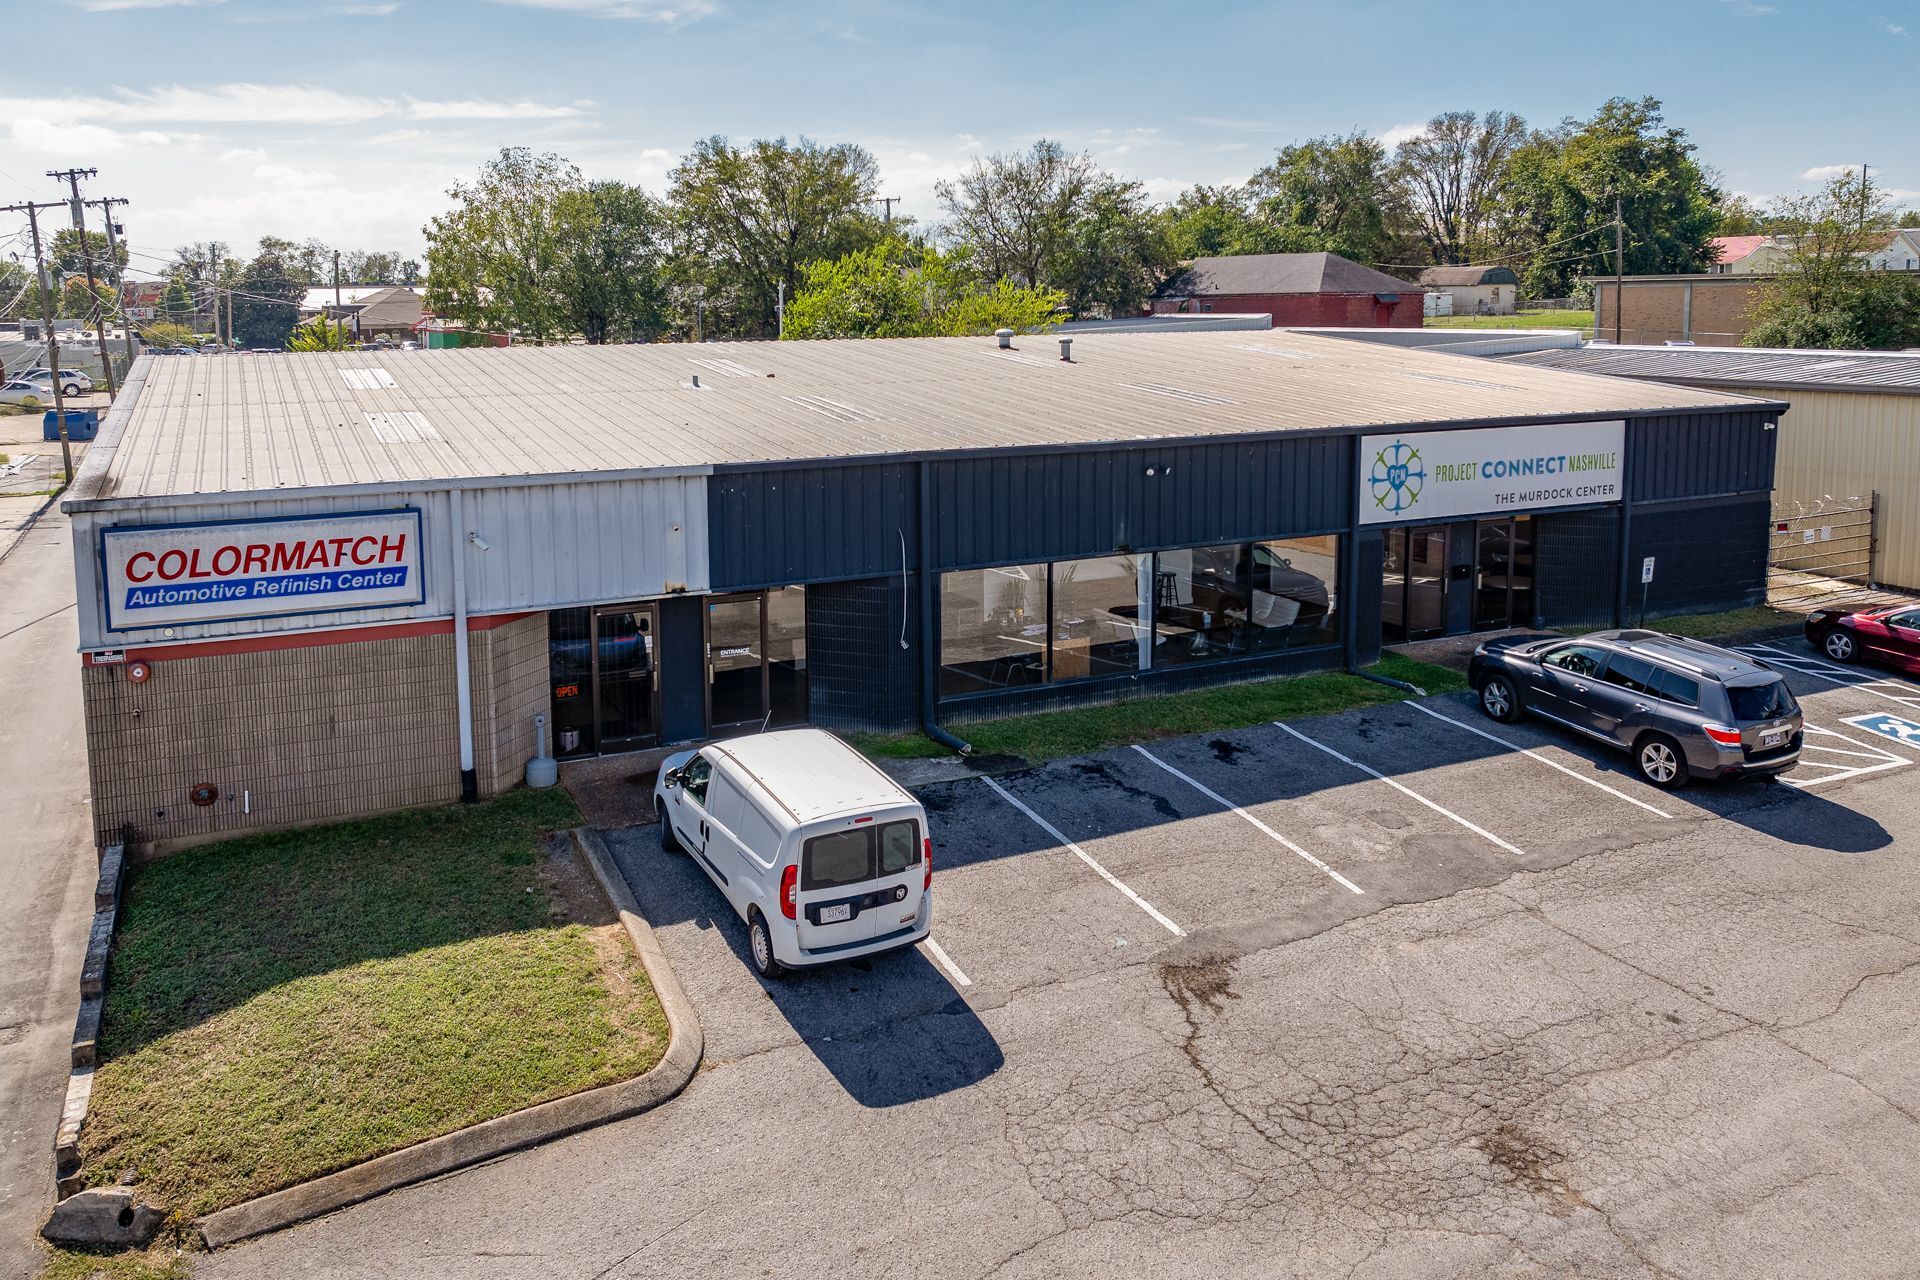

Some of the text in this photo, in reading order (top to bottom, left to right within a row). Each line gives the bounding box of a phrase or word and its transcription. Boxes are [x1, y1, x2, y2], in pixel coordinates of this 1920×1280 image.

[1390, 468, 1406, 484] PCN
[1435, 453, 1616, 483] PROJECT CONNECT NASHVILLE
[1495, 484, 1615, 504] THE MURDOCK CENTER
[125, 533, 406, 583] COLORMATCH
[129, 570, 403, 607] Automotive Refinish Center
[721, 648, 750, 656] ENTRANCE
[556, 686, 578, 698] OPEN
